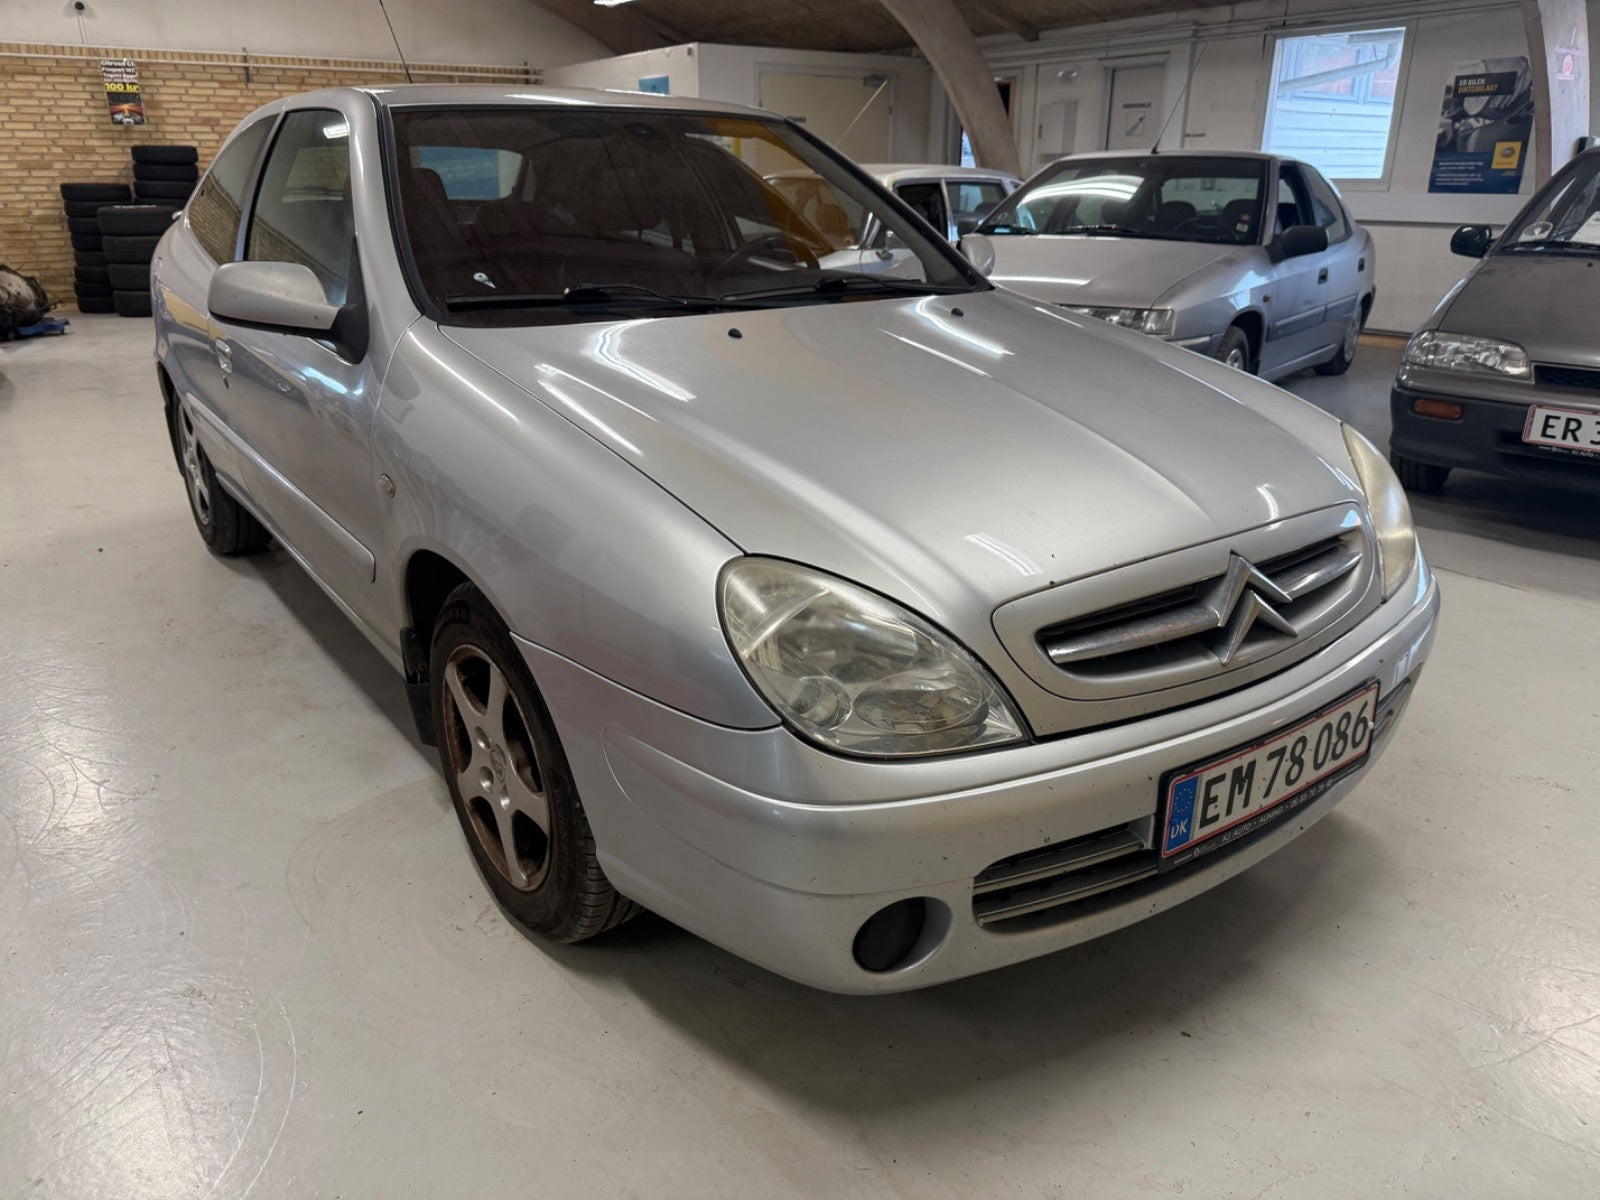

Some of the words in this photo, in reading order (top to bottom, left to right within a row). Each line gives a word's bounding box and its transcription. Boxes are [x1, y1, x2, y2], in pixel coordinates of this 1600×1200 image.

[104, 83, 125, 91] 100
[1541, 414, 1583, 442] ER
[1198, 759, 1257, 830] EM
[1262, 735, 1308, 800] 78
[1313, 700, 1369, 771] 086
[1170, 818, 1188, 840] DK
